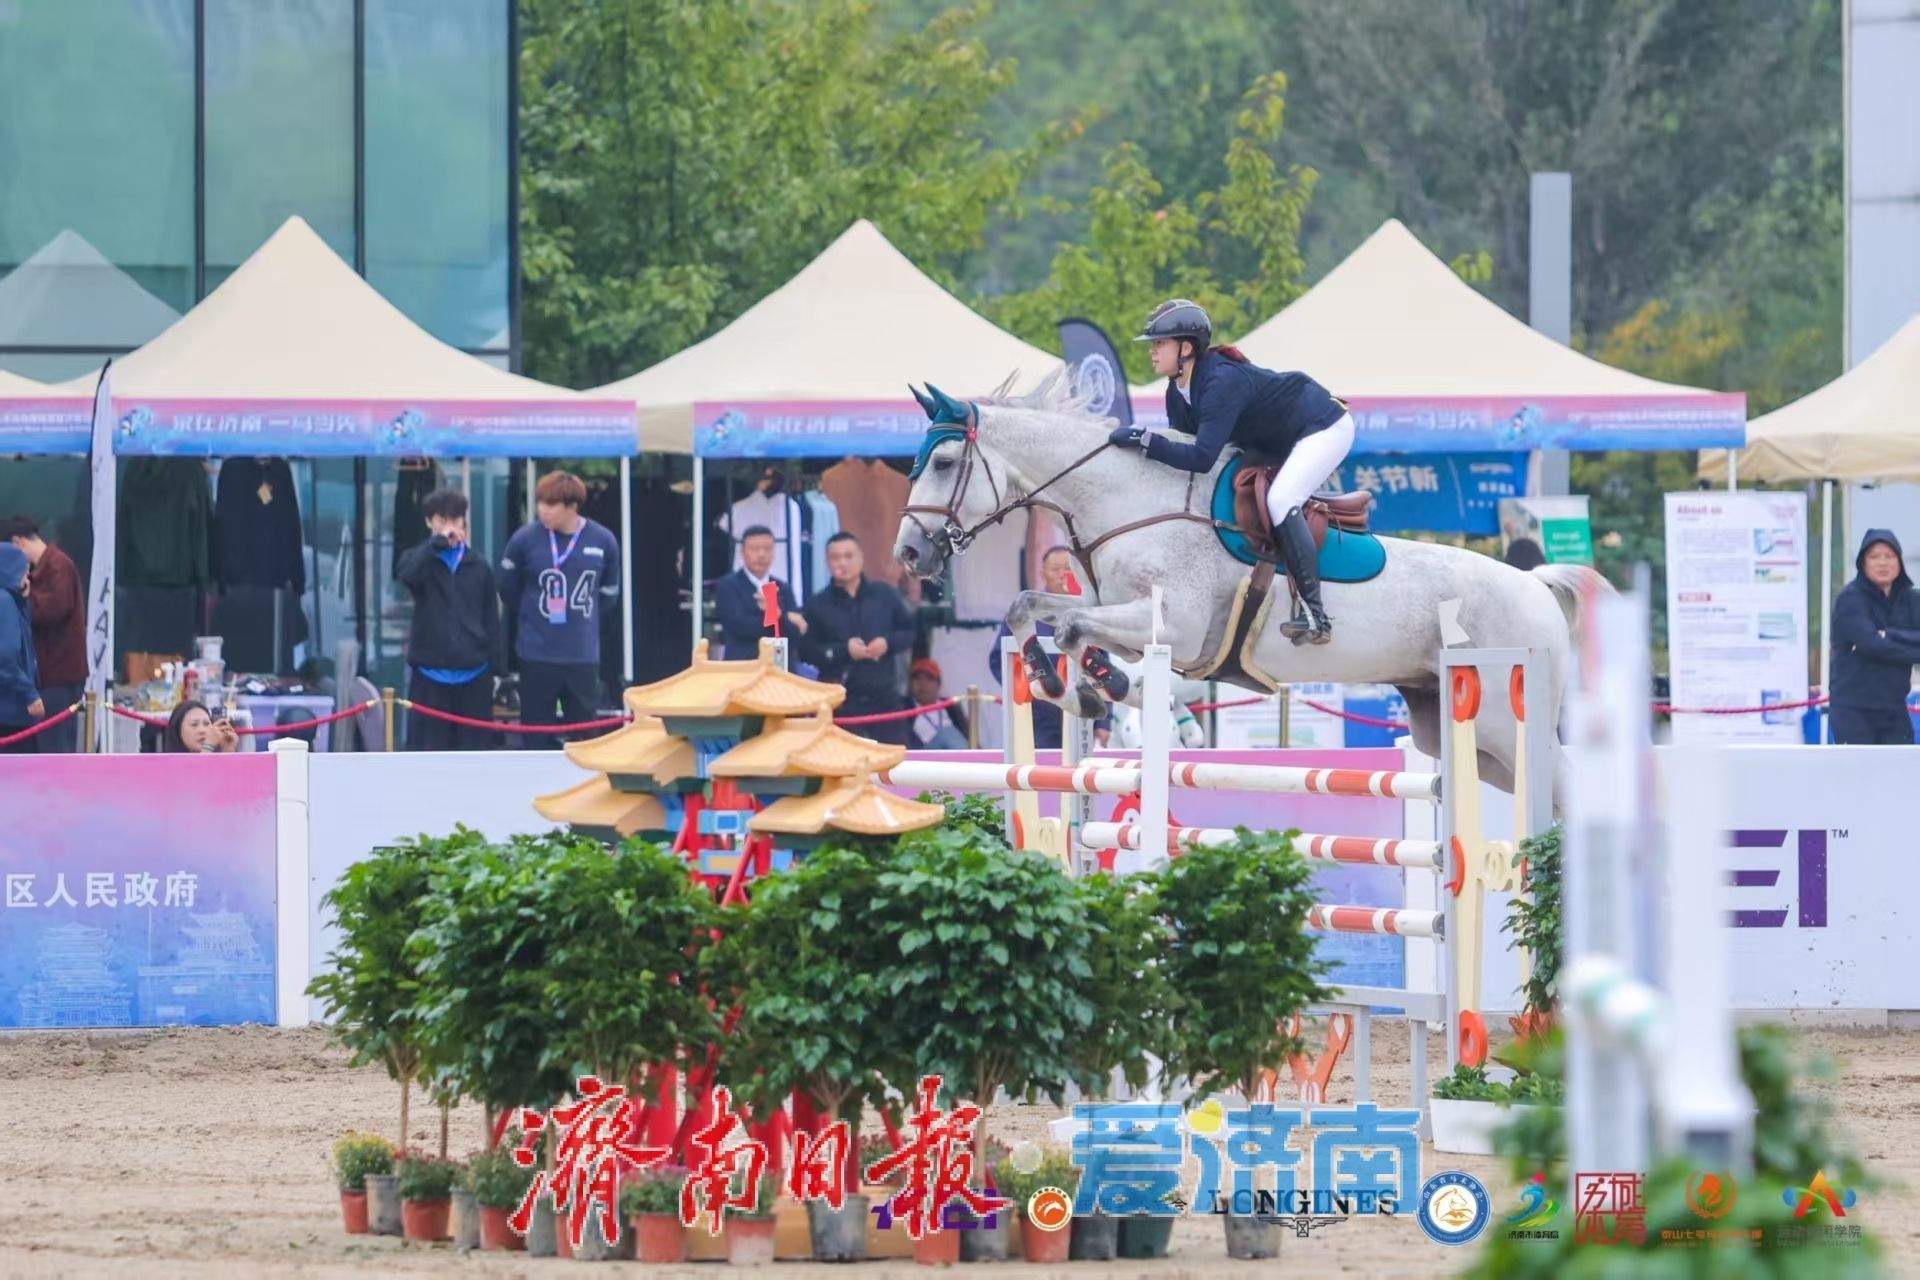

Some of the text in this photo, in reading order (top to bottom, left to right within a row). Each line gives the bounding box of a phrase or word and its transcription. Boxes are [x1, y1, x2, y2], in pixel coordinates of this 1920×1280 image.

[6, 870, 198, 907] 区人民政府
